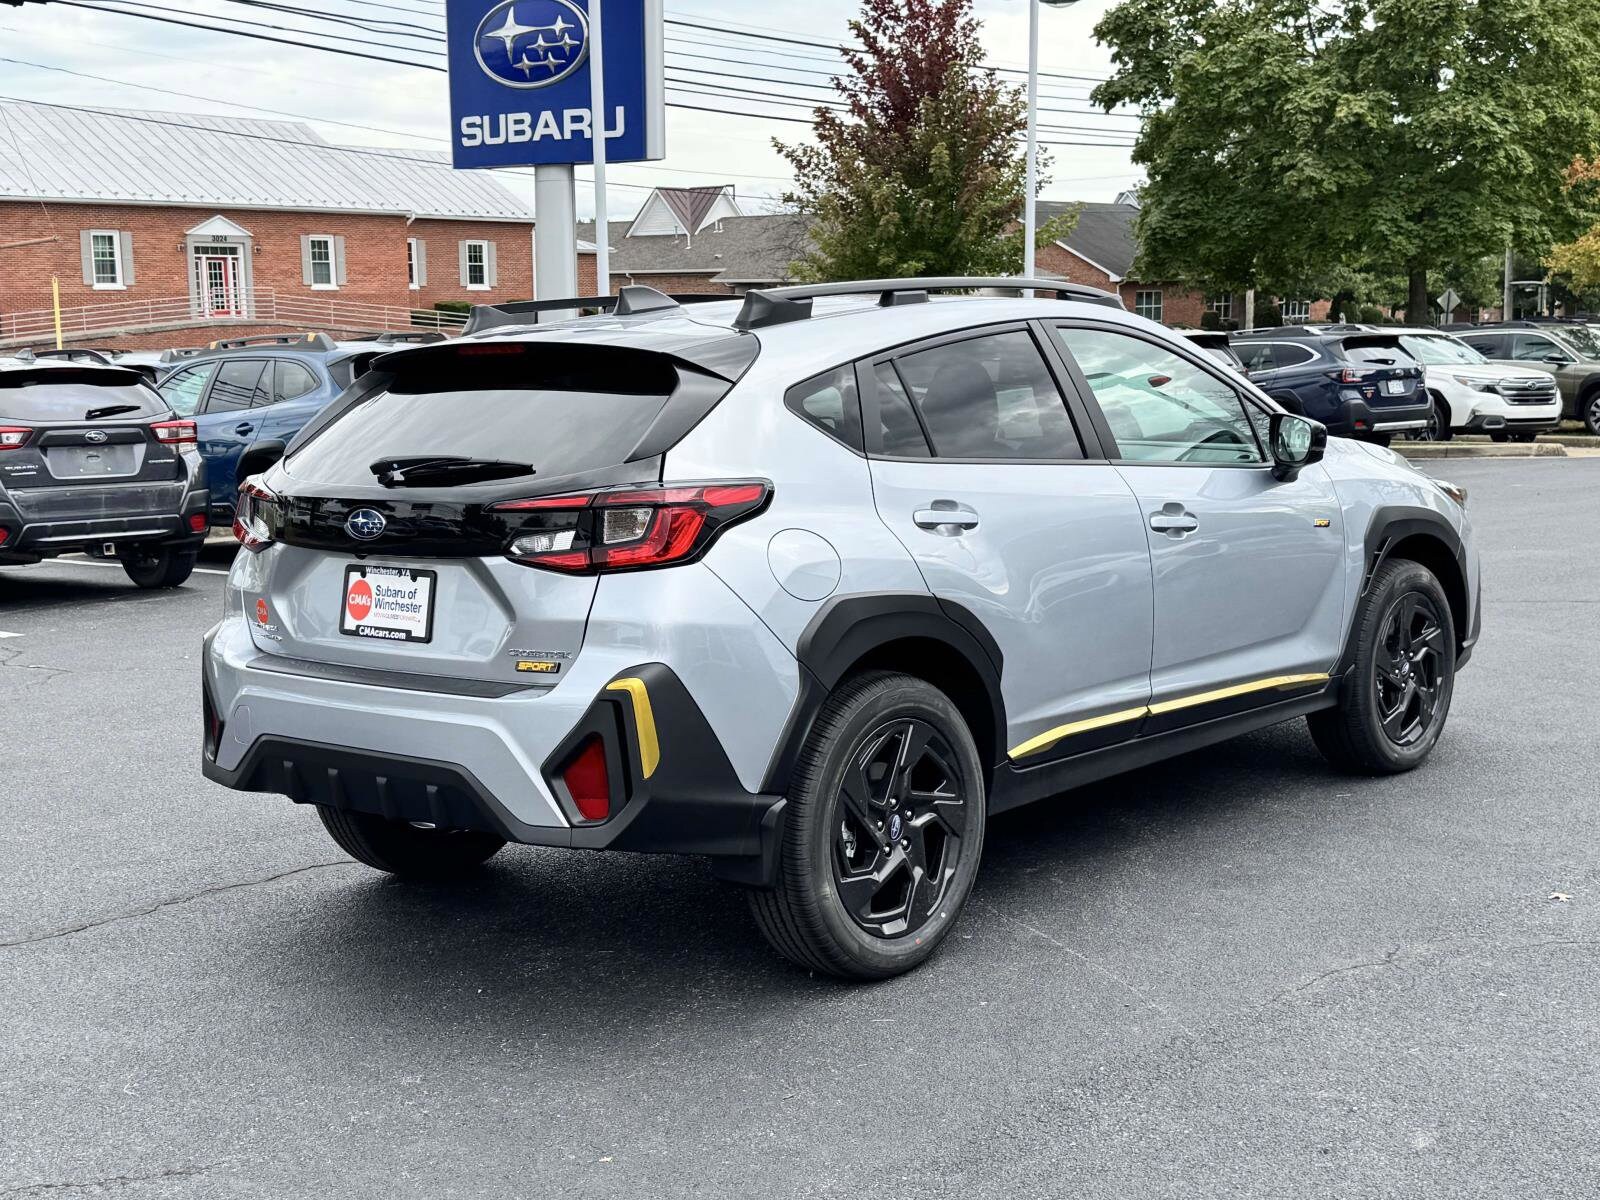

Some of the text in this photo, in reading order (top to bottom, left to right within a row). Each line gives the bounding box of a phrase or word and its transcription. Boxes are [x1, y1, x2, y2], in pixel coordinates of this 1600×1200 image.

[461, 106, 625, 147] SUBARU
[366, 567, 410, 577] Winchester, VA
[349, 594, 371, 605] CMA's
[375, 585, 418, 600] Subaru of
[374, 597, 422, 614] Winchester
[358, 626, 406, 640] CMAcars.com
[518, 662, 554, 671] SPORT
